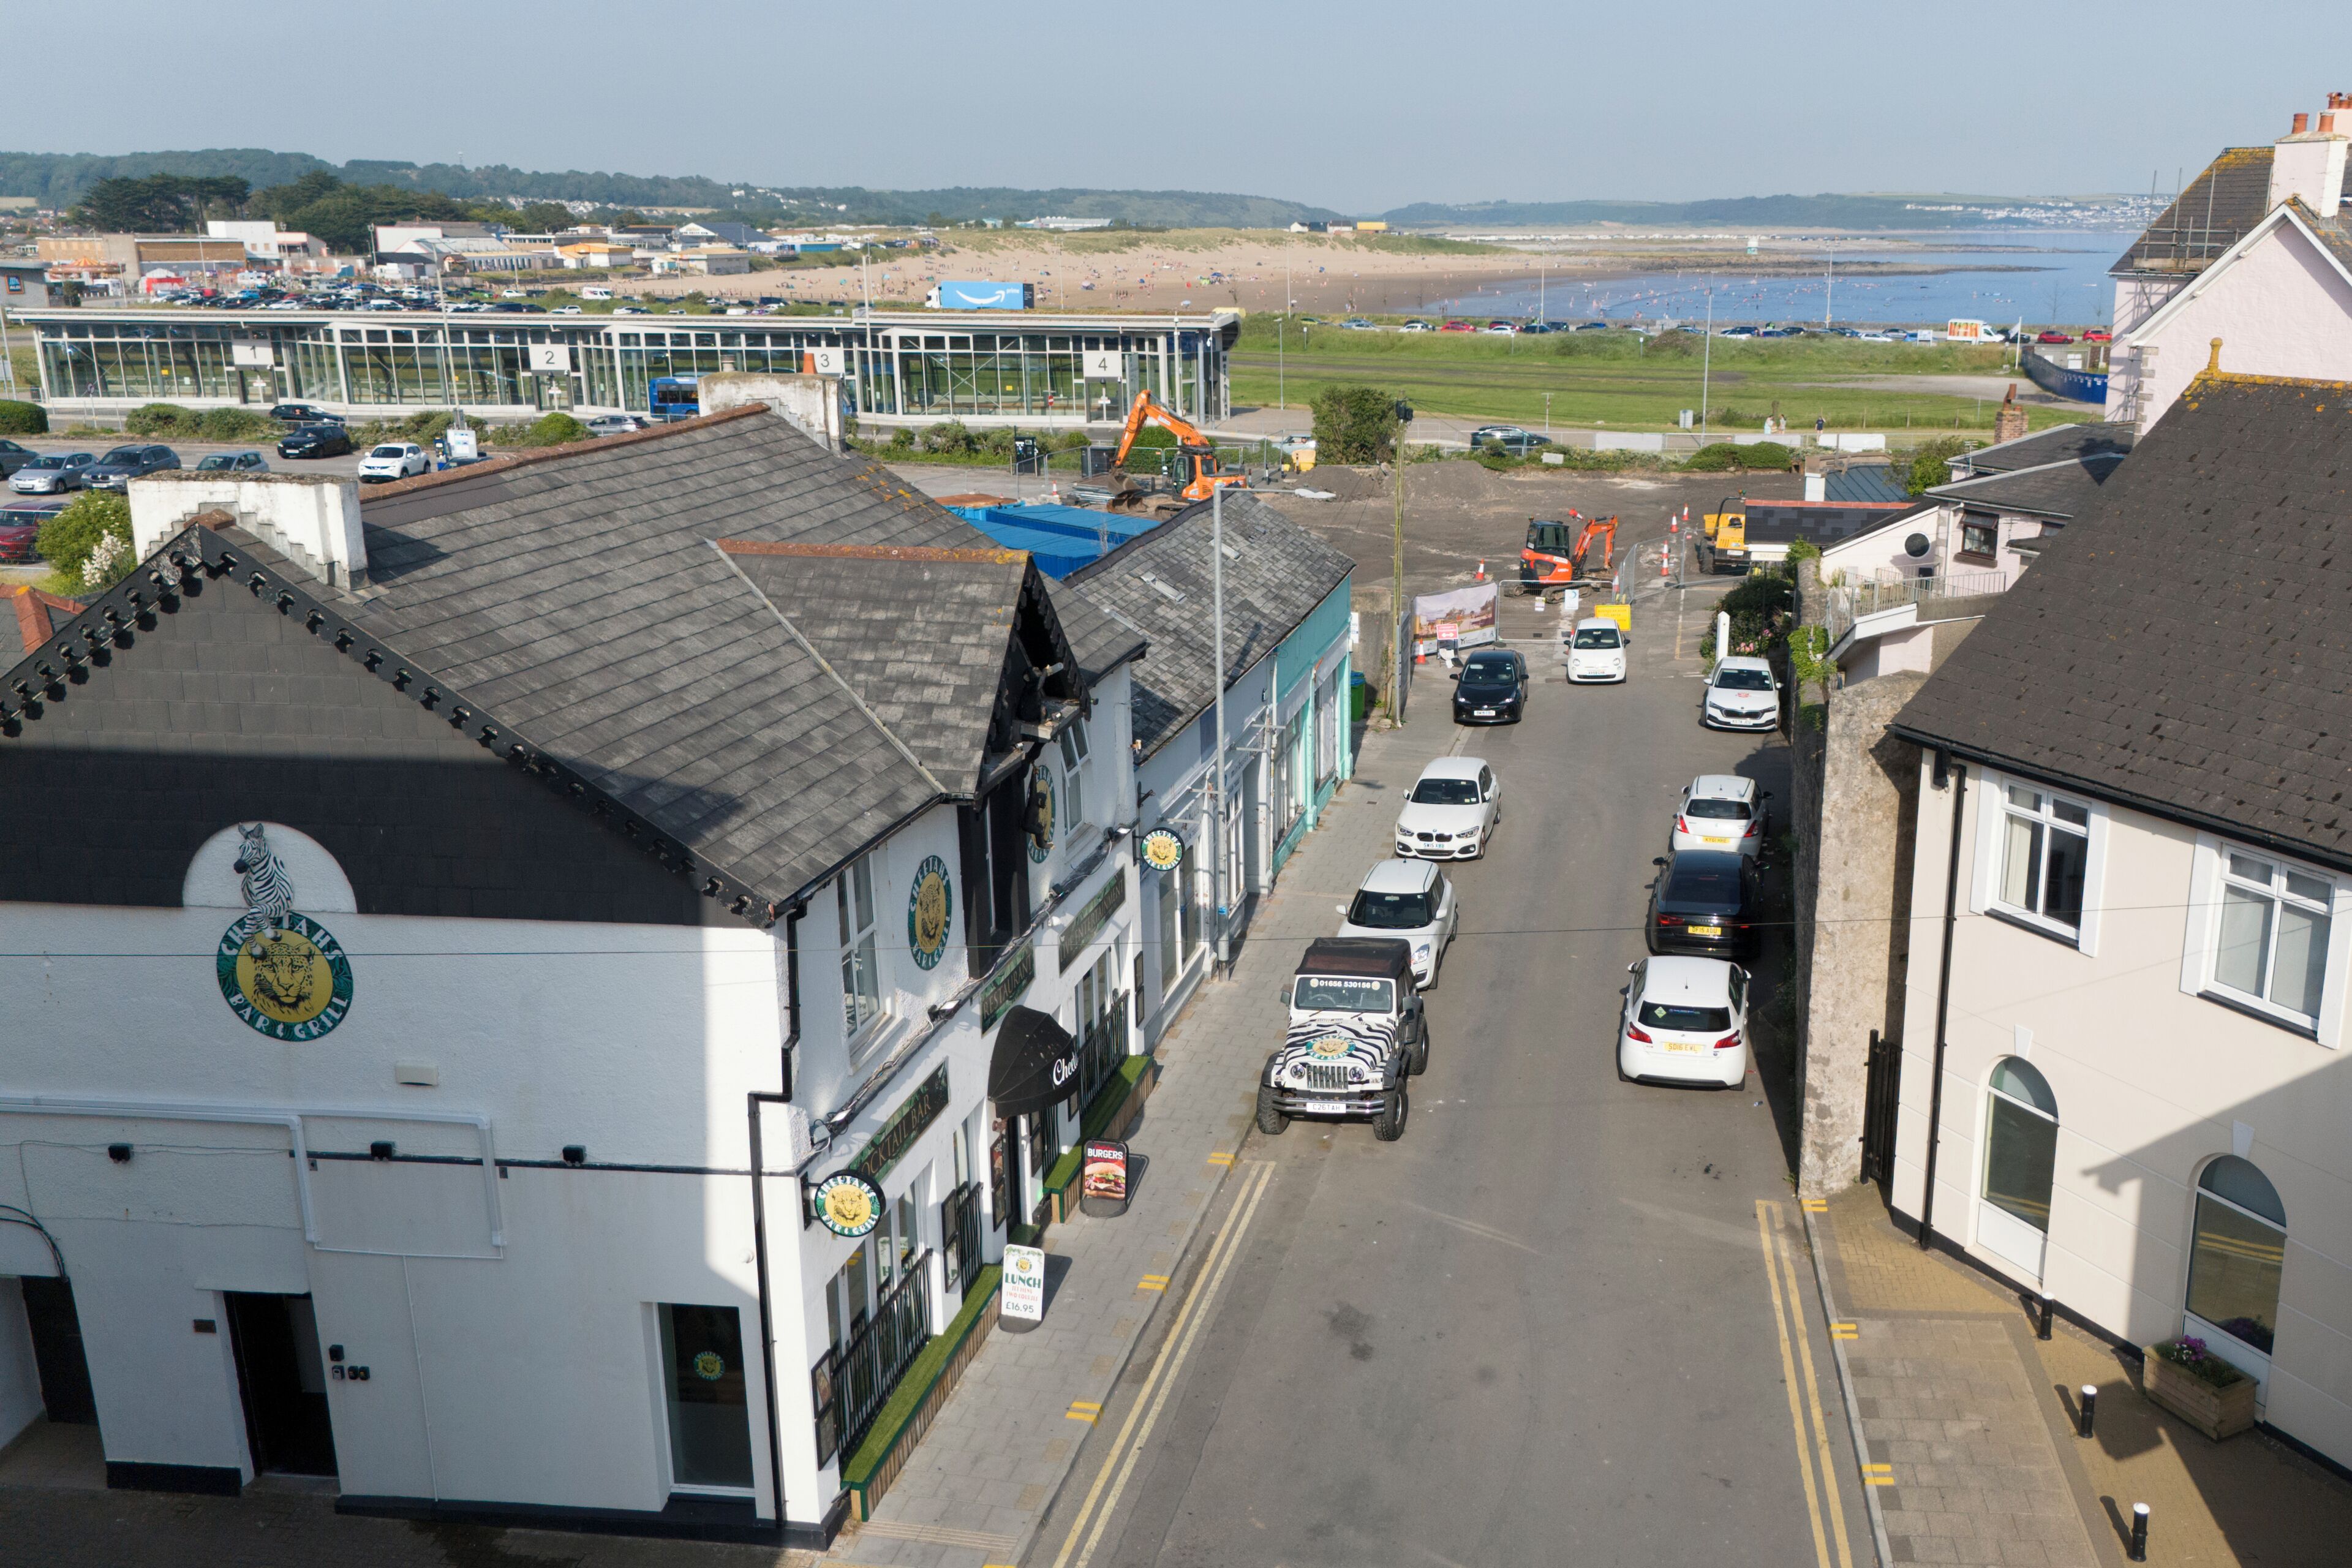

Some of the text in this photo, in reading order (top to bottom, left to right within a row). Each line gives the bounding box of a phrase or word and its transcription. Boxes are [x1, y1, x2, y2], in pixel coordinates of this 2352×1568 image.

[250, 345, 257, 359] 1
[545, 350, 555, 364] 2
[821, 353, 829, 368] 3
[1098, 357, 1107, 371] 4
[1143, 830, 1182, 846] CHEETAHS
[1144, 855, 1156, 867] BAR
[1162, 856, 1181, 870] GRILL
[910, 857, 949, 911] CHEETAHS
[1074, 878, 1125, 940] ENTERTAINMENT
[221, 911, 344, 960] CHTAHS
[912, 943, 927, 967] BAR
[934, 916, 951, 963] GRILL
[982, 955, 1032, 1019] RESTAURANT
[229, 993, 270, 1032] BAR
[294, 997, 349, 1038] GRILL
[861, 1094, 930, 1176] OCKTAIL BAR
[1088, 1148, 1123, 1159] BURGERS
[818, 1175, 876, 1199] CHEETAHS
[821, 1214, 842, 1233] BAR
[852, 1214, 878, 1235] GRILL
[1005, 1273, 1041, 1289] LUNCH
[1006, 1301, 1034, 1313] £16.95
